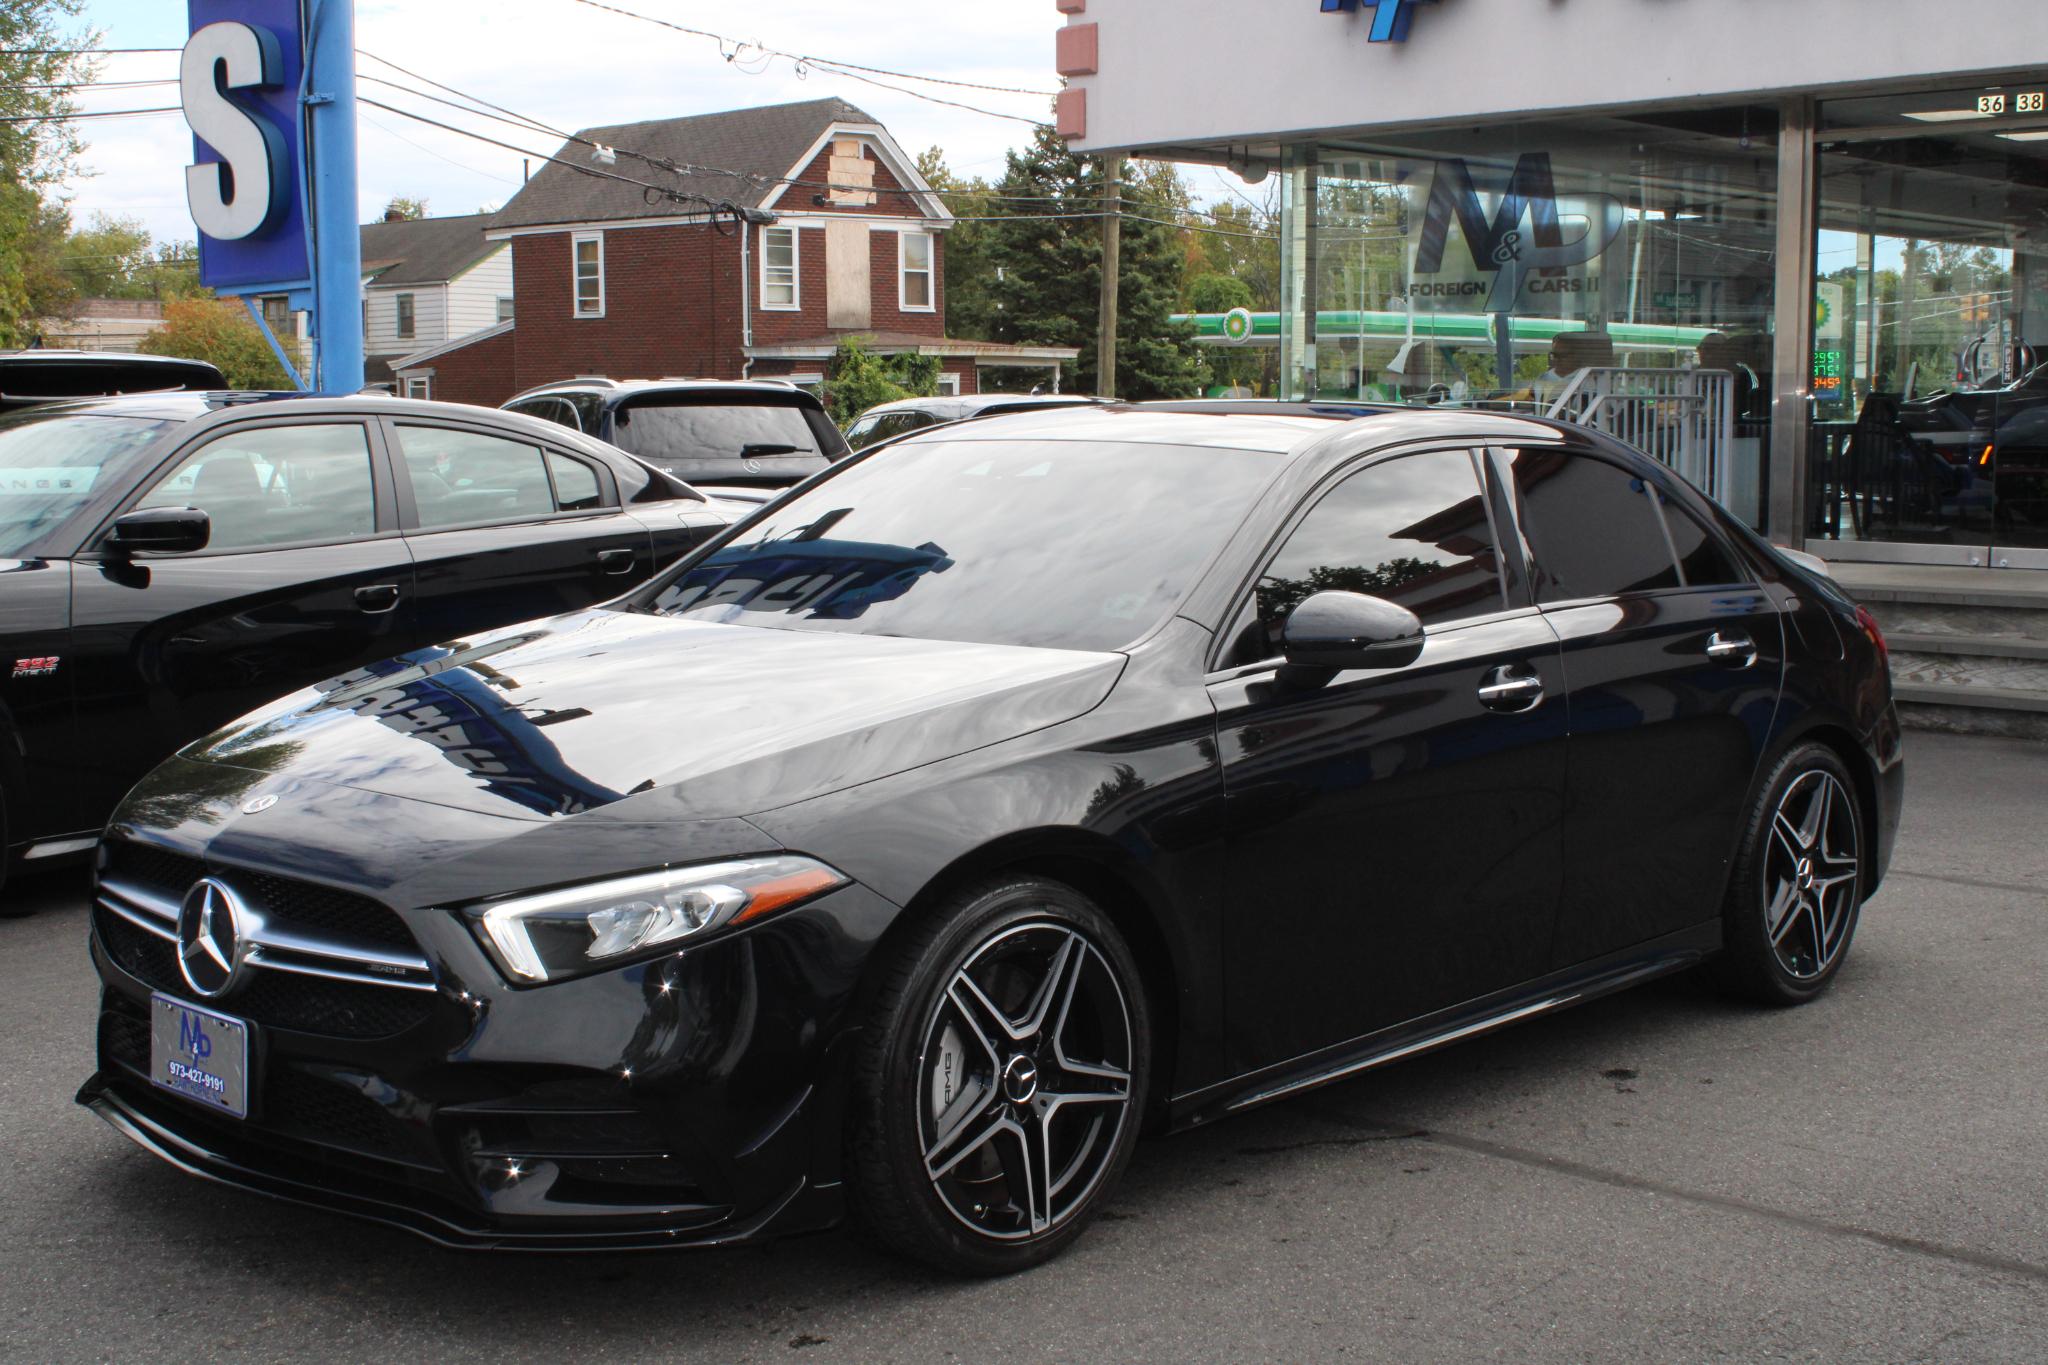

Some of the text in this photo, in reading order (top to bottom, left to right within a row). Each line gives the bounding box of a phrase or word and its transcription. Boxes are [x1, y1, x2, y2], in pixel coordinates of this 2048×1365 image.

[1980, 94, 2041, 113] 36 38
[179, 21, 273, 240] S
[1410, 281, 1486, 297] FOREIGN
[1528, 277, 1582, 294] CARS
[14, 656, 60, 670] 392
[169, 1061, 225, 1093] 973-427-9191
[944, 1052, 952, 1105] AMG
